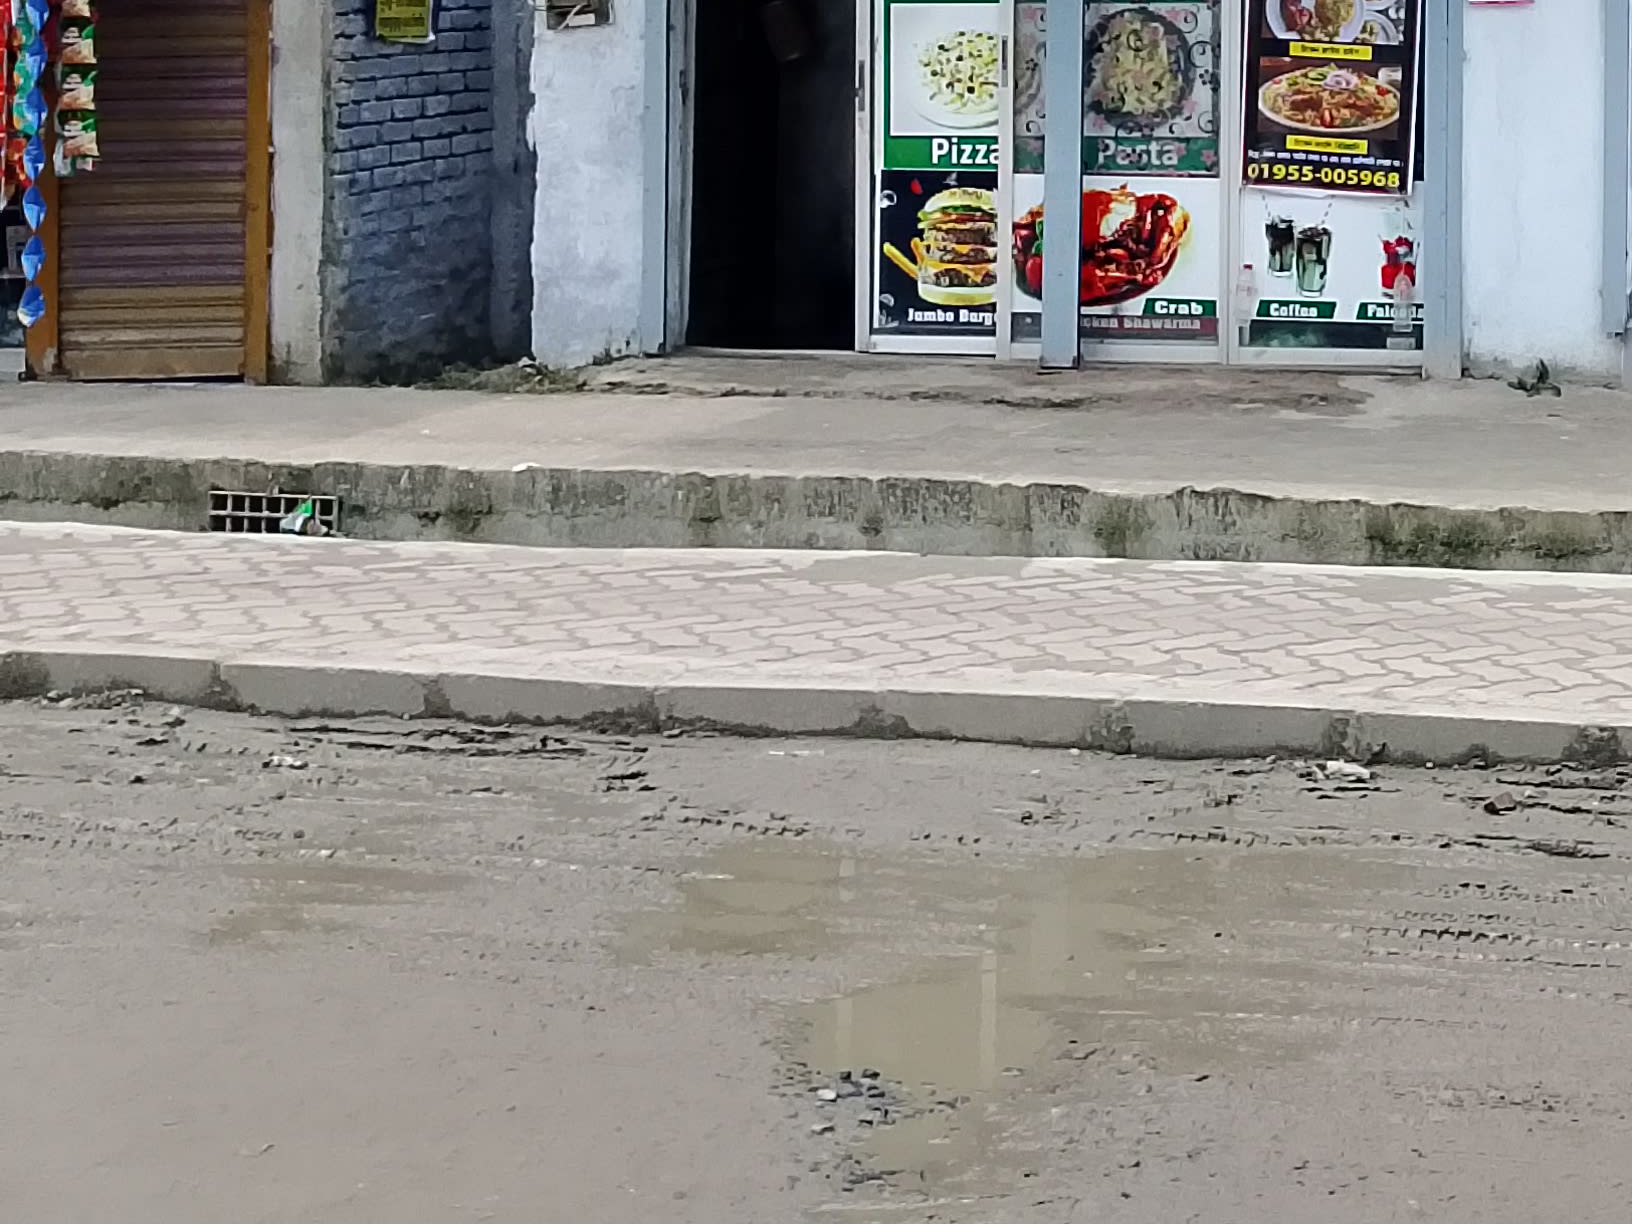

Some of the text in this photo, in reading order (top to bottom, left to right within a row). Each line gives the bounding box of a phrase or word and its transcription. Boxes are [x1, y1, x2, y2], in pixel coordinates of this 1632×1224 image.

[1098, 139, 1179, 165] Pasta
[1248, 163, 1400, 188] 01955-005968
[1154, 300, 1204, 315] Crab
[1269, 303, 1318, 317] Coffee
[959, 309, 997, 325] Burg
